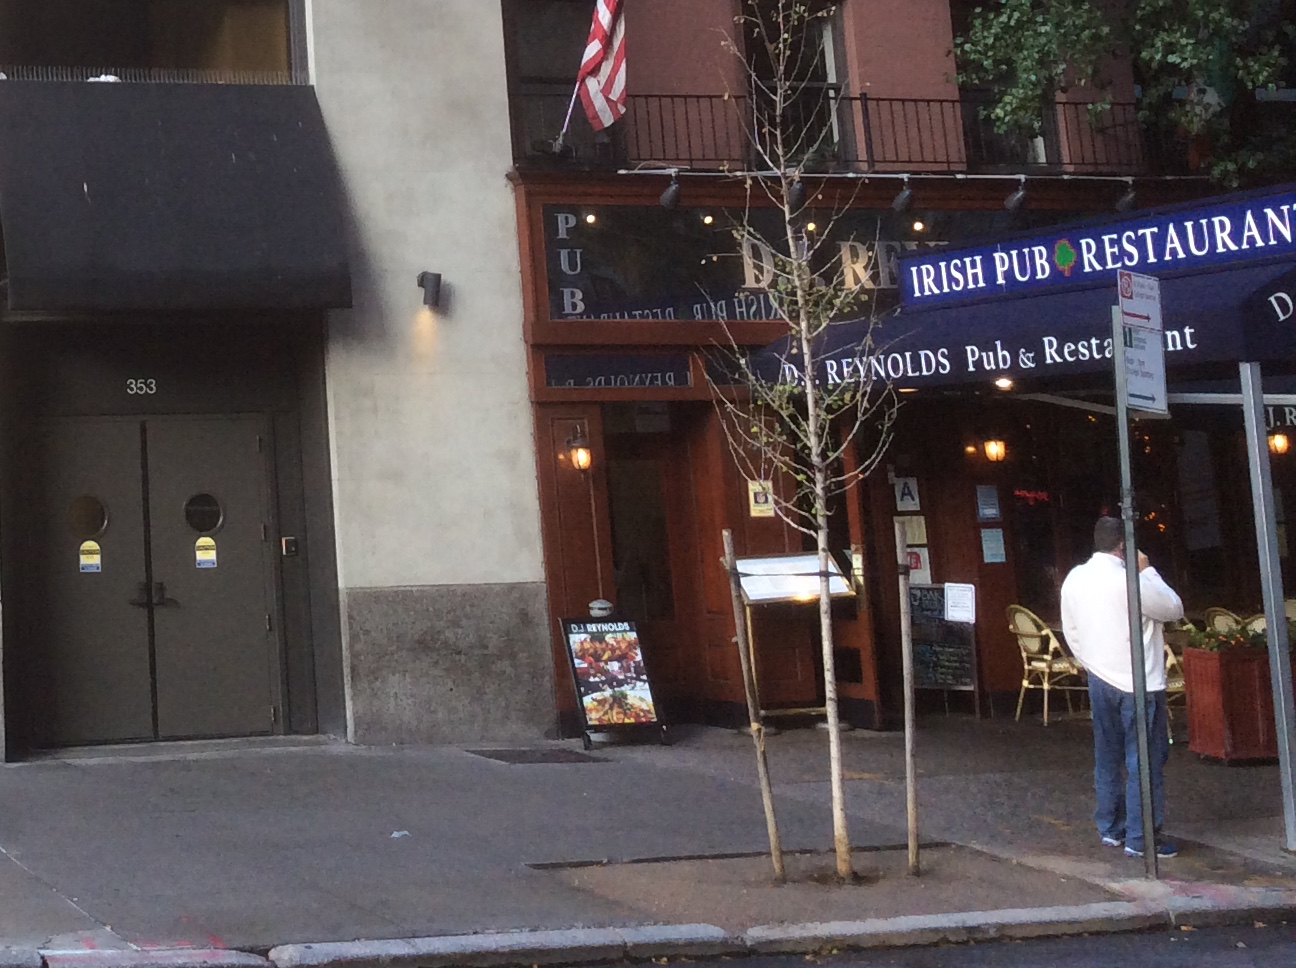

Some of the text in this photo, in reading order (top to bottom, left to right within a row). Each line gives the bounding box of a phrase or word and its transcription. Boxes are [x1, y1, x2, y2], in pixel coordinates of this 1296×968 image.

[555, 213, 585, 315] PUB
[910, 203, 1296, 298] IRISH PUB RESTAURAN
[825, 348, 950, 384] REYNOLDS
[966, 340, 1012, 373] Pub
[1018, 349, 1037, 369] &
[1045, 325, 1198, 364] Restant
[126, 378, 157, 394] 353
[900, 482, 915, 502] A
[586, 622, 630, 632] REYNOLDS
